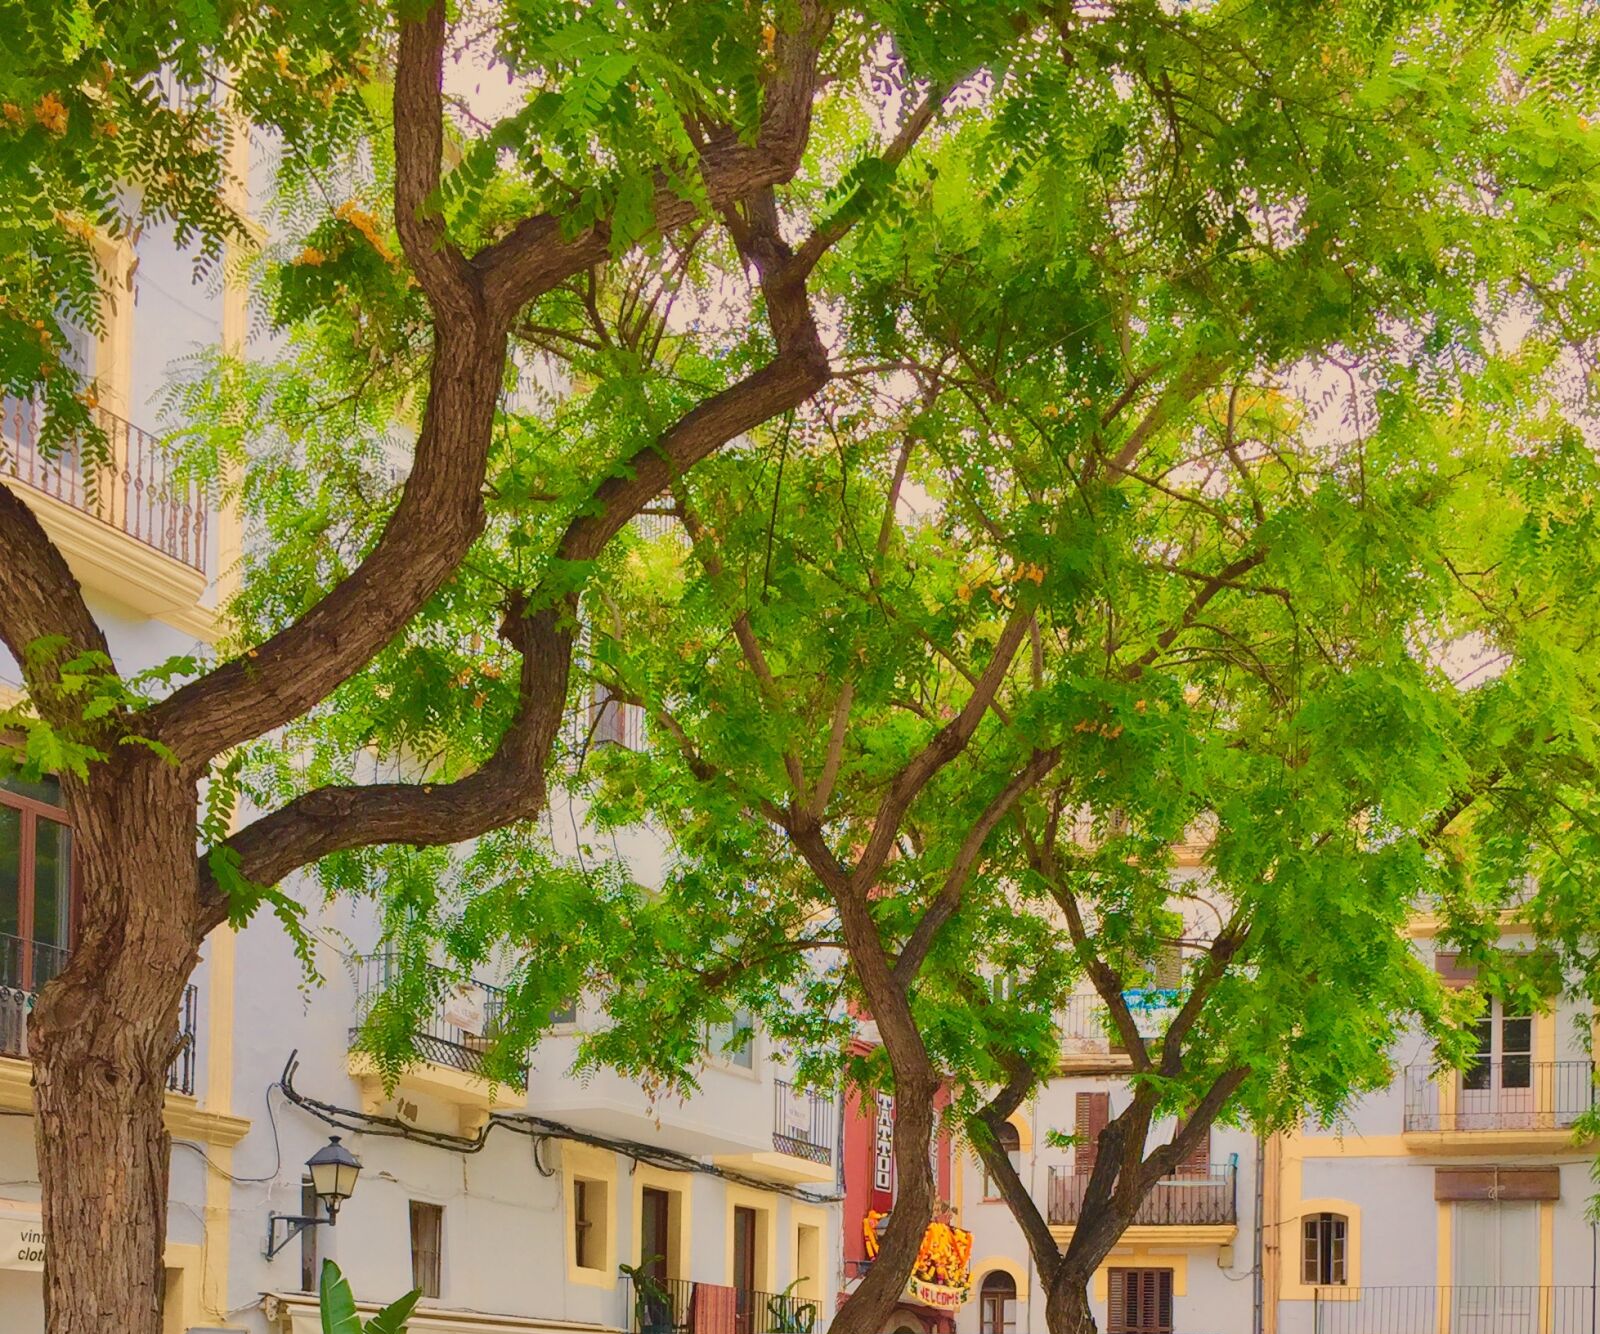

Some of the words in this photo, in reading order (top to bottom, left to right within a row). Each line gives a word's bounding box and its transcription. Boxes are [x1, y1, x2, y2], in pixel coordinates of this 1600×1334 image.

[876, 1091, 893, 1190] TATTOO
[18, 1247, 45, 1262] clot
[920, 1287, 960, 1305] WELCOME
